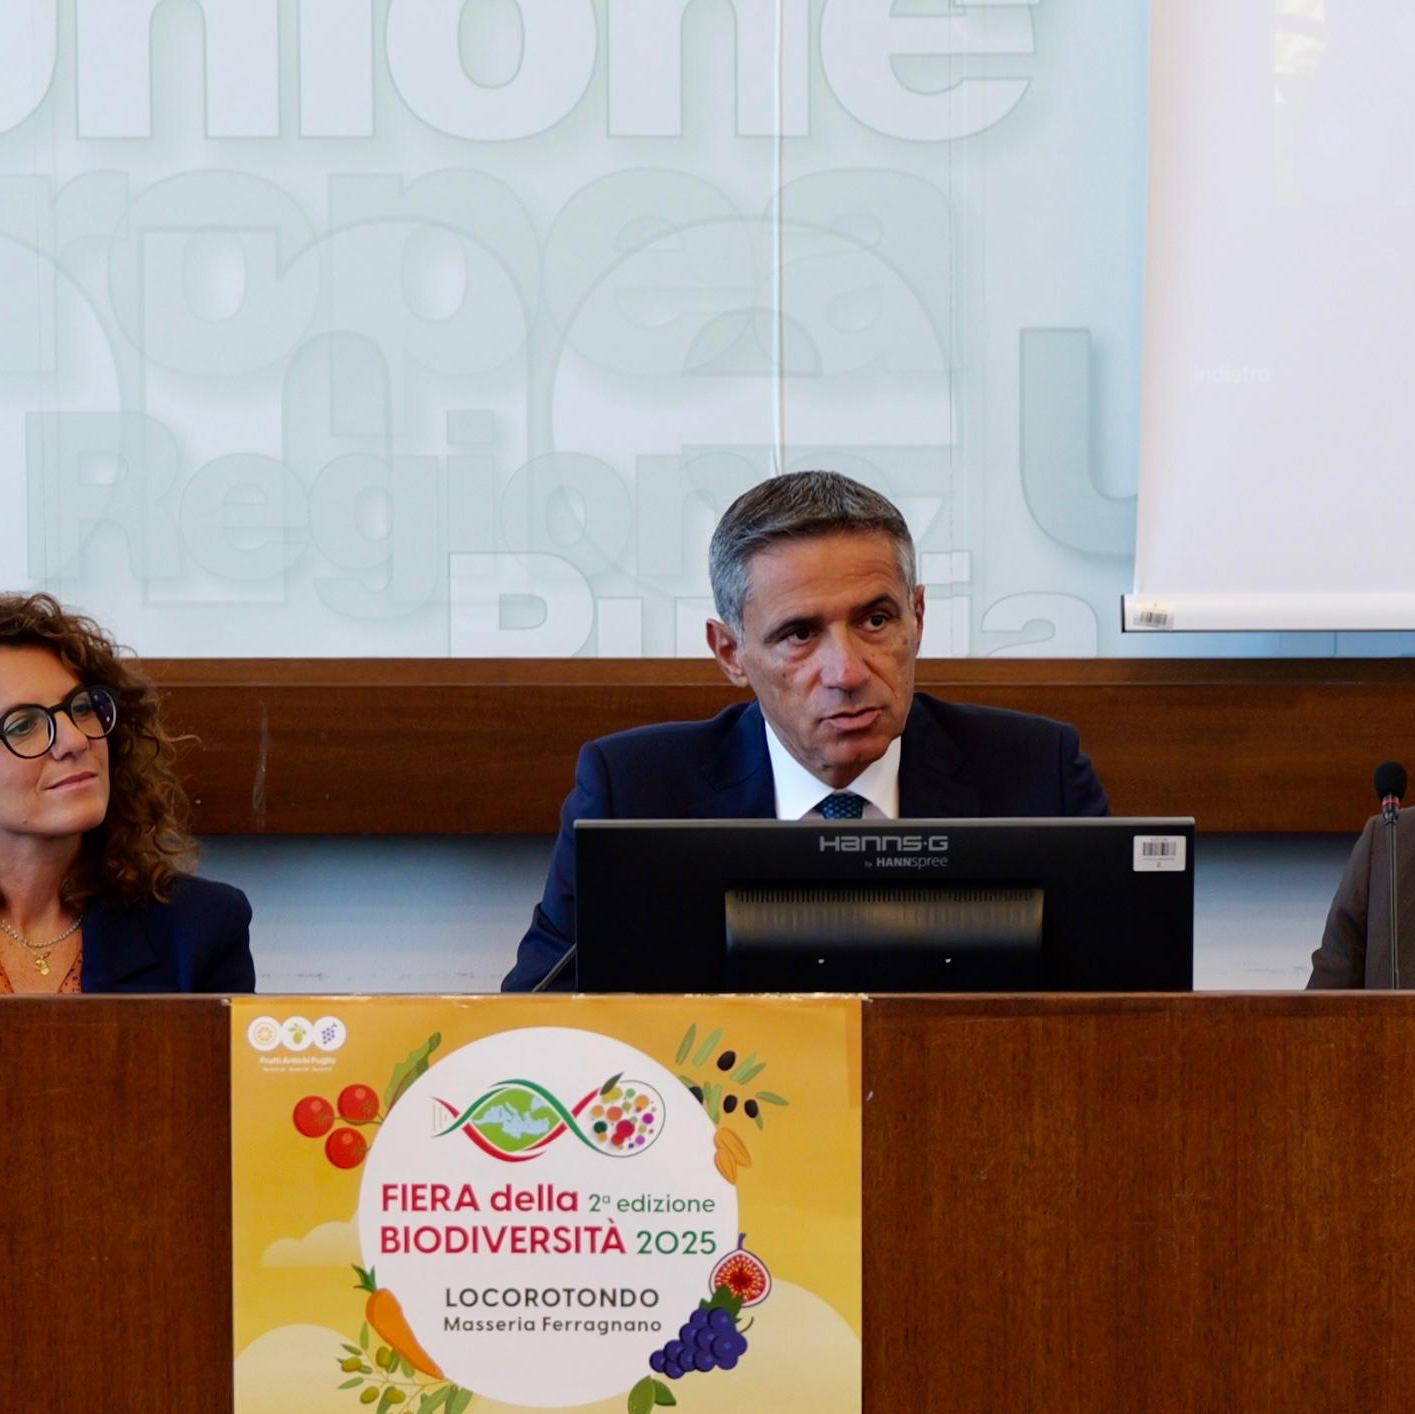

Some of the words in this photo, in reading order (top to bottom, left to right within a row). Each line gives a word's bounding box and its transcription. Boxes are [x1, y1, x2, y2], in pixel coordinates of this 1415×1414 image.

[382, 1183, 480, 1212] FIERA
[490, 1183, 579, 1212] della
[617, 1194, 715, 1213] edizione
[381, 1218, 626, 1254] BIODIVERSITÀ
[637, 1231, 716, 1254] 2025
[446, 1288, 659, 1308] LOCOROTONDO
[444, 1316, 536, 1332] Masseria
[542, 1316, 661, 1335] Ferragnano
